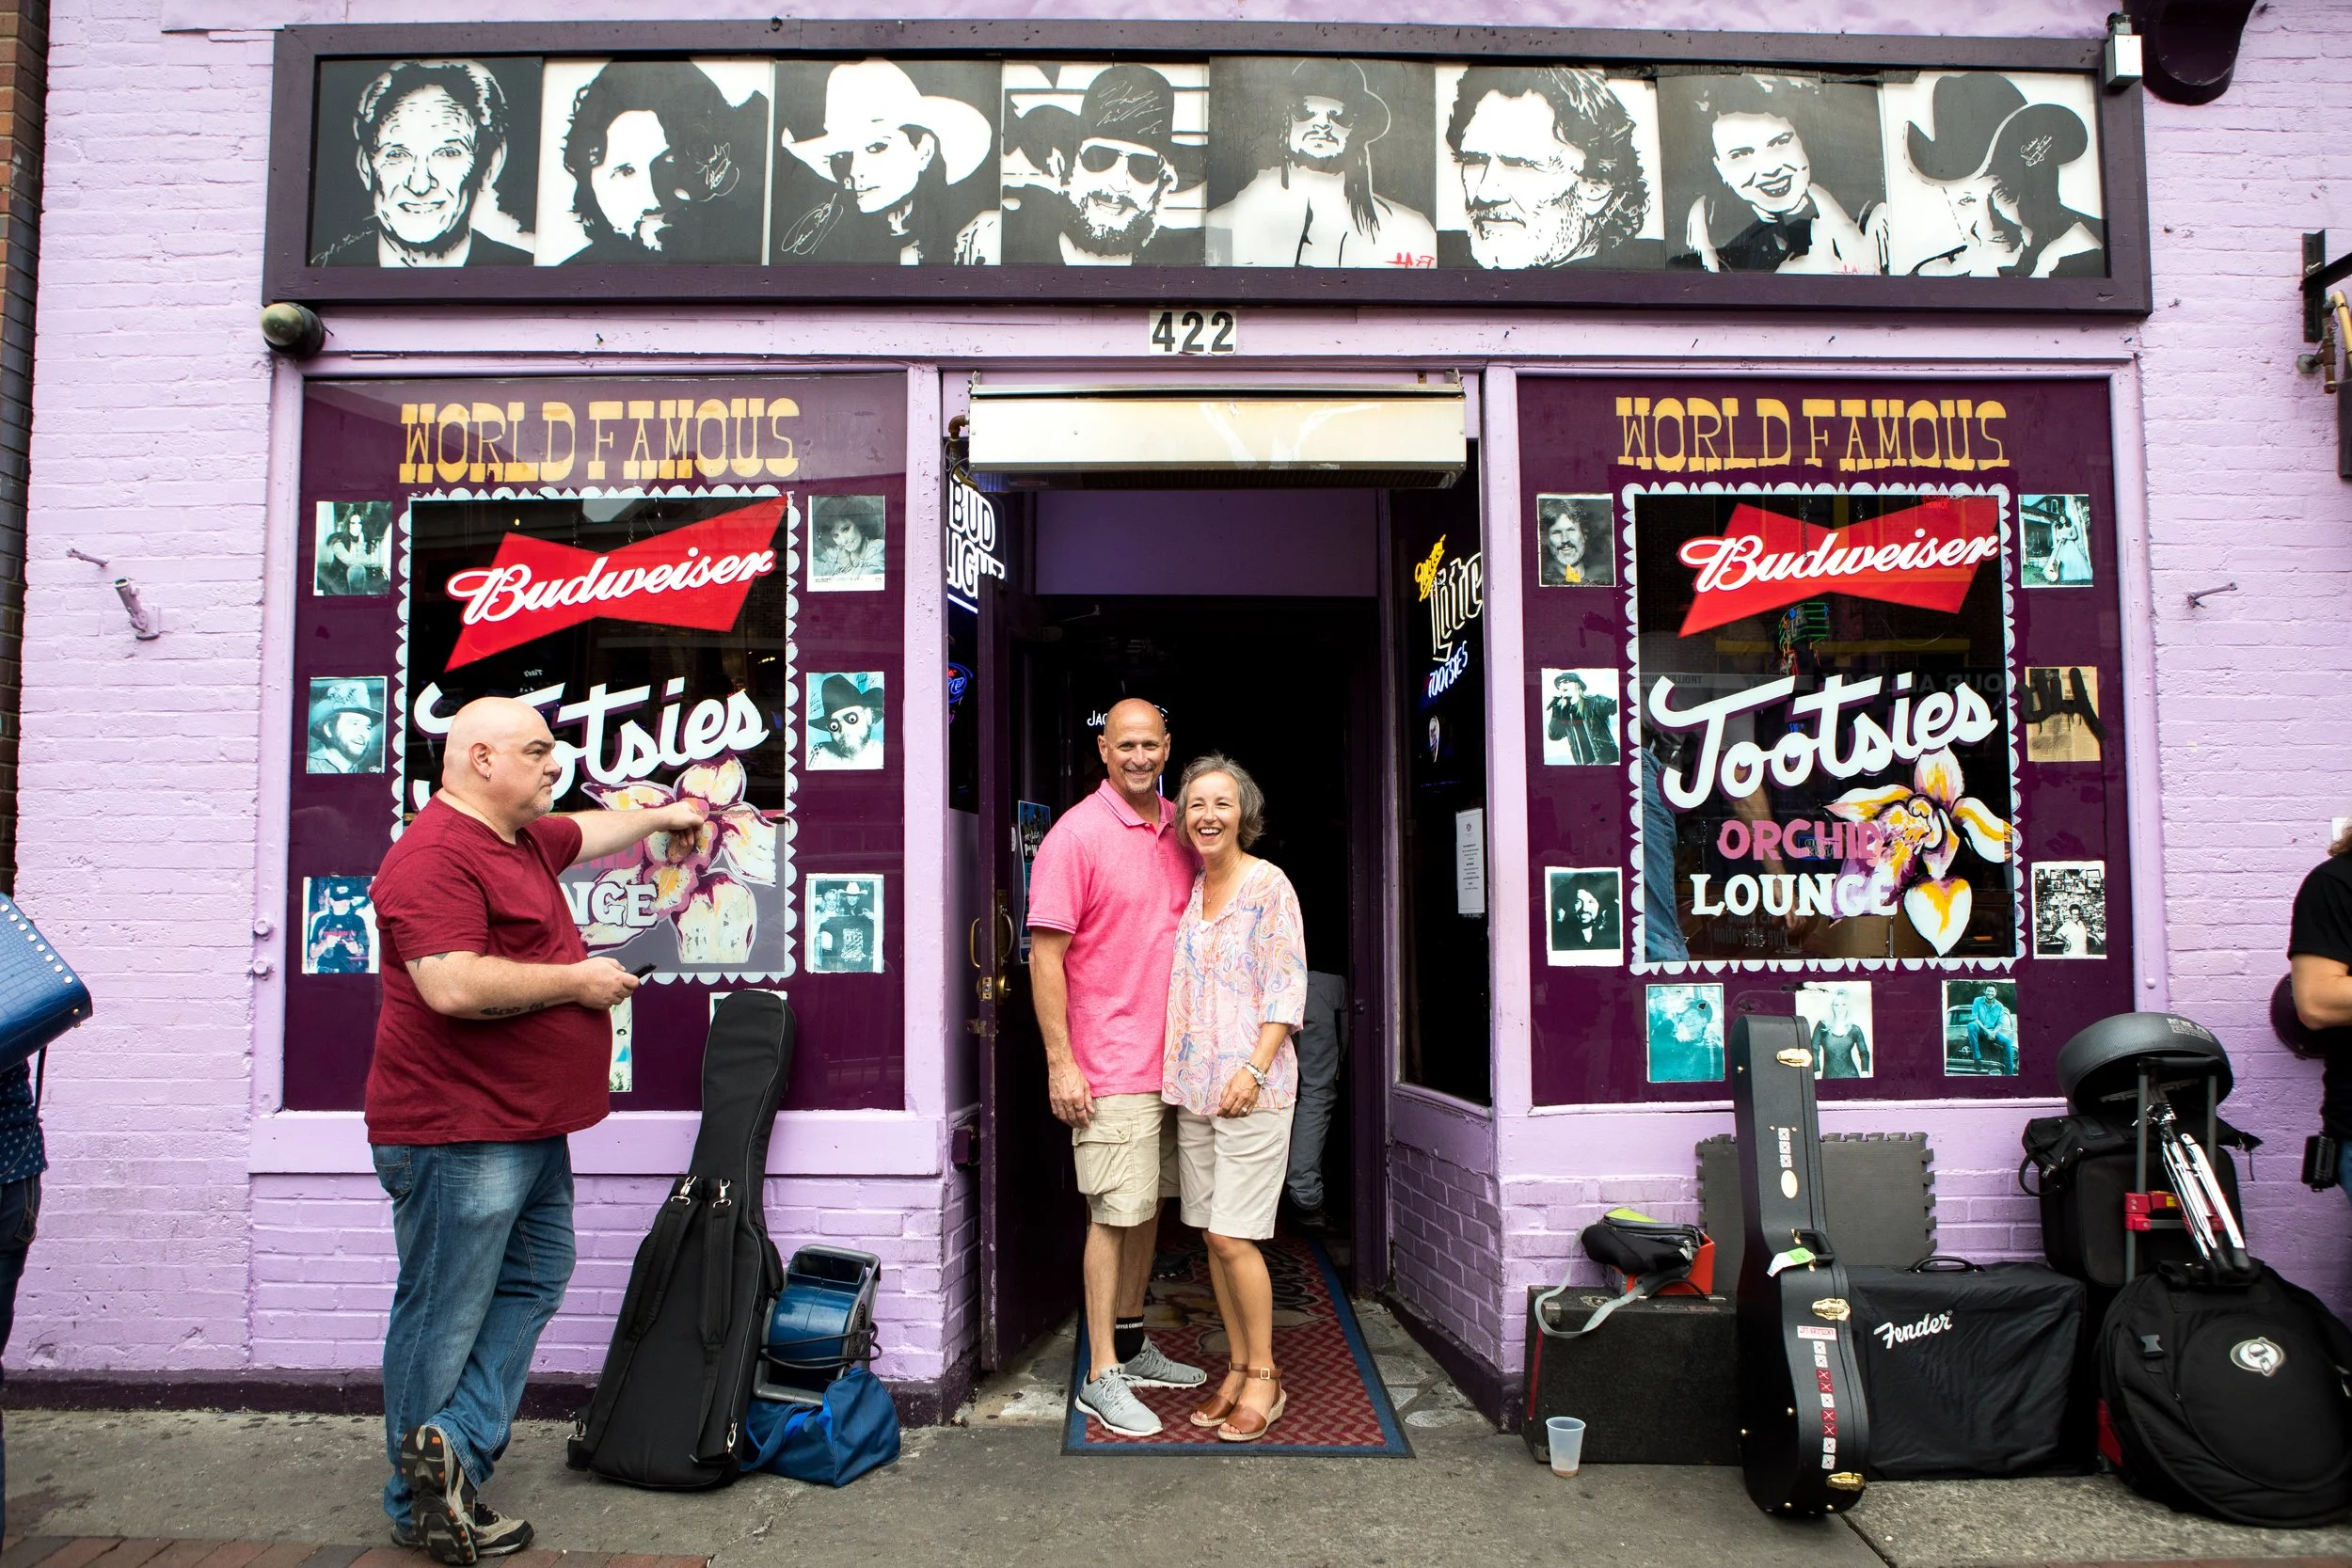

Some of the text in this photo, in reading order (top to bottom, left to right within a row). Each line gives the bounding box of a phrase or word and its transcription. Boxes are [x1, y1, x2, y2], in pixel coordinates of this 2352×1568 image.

[1152, 311, 1235, 353] 422
[400, 398, 800, 483] WORLD FAMOUS
[1615, 397, 2010, 472] WORLD FAMOUS
[948, 473, 995, 552] BUD
[447, 546, 775, 626] Budweiser
[1680, 528, 1999, 594] Budweiser
[1429, 552, 1484, 662] Lite
[413, 676, 770, 813] tsies
[1087, 709, 1108, 726] JAC
[1648, 672, 1998, 809] Tootsies
[1717, 818, 1883, 865] ORCHID
[560, 881, 659, 927] NGE
[1689, 873, 1899, 918] LOUNGE
[1873, 1311, 1953, 1350] Fender
